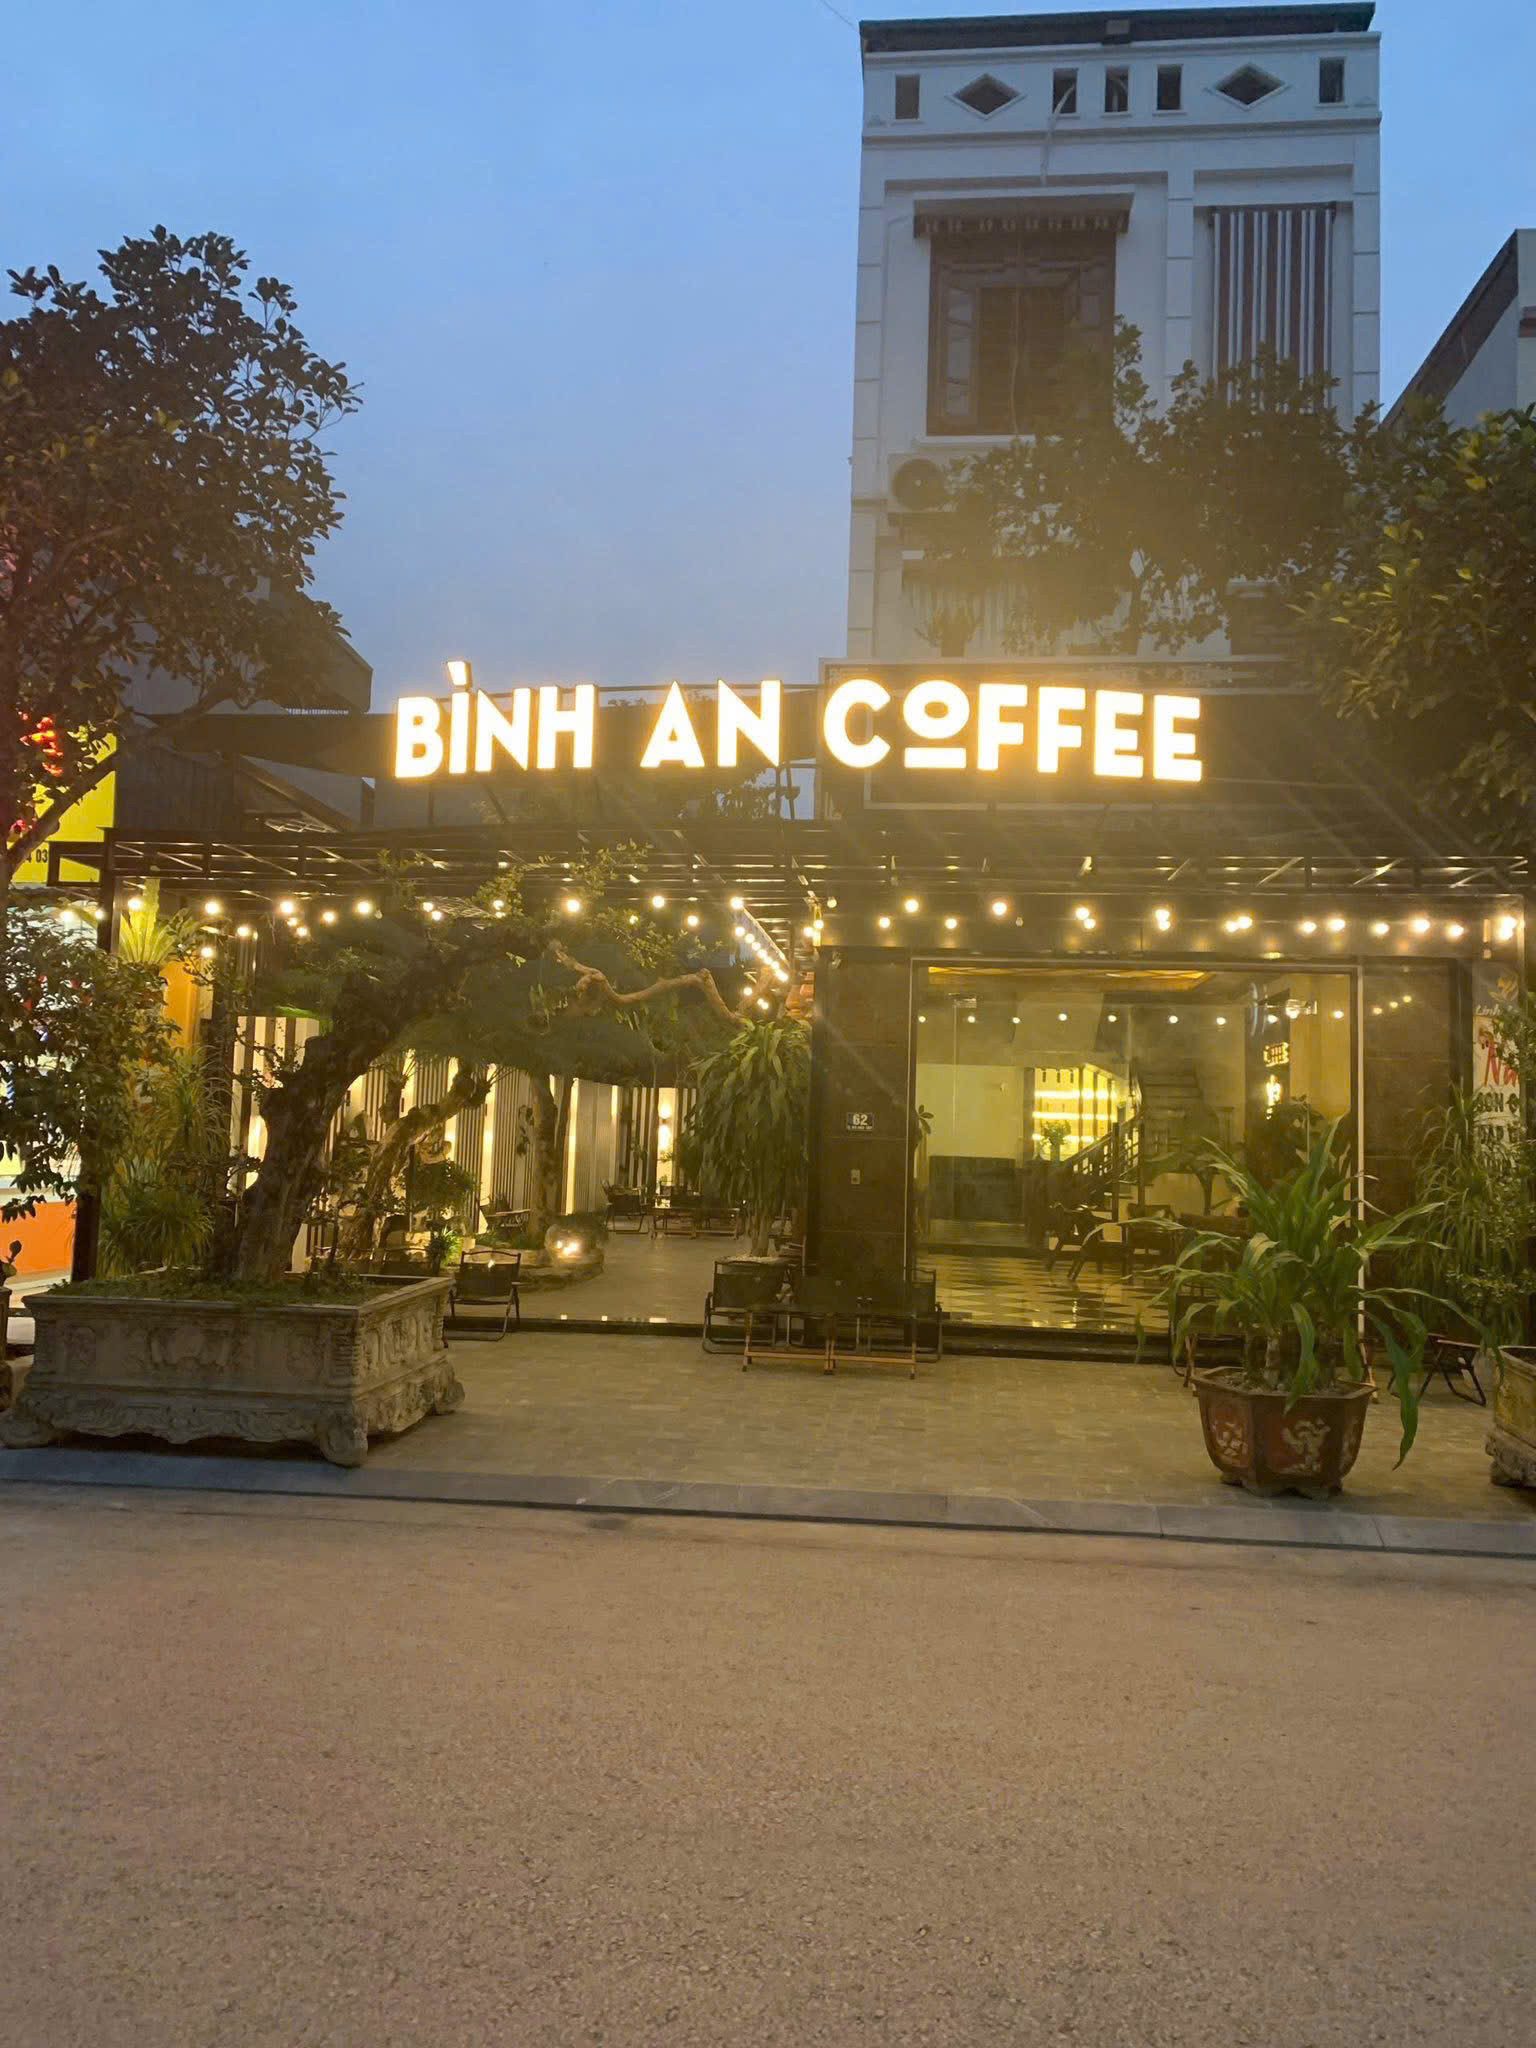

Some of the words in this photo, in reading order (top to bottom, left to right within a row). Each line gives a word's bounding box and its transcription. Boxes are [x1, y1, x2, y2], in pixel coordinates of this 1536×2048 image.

[395, 660, 598, 778] BÌNH
[639, 679, 783, 768] AN
[823, 678, 1203, 782] COFFEE
[852, 1113, 868, 1126] 62
